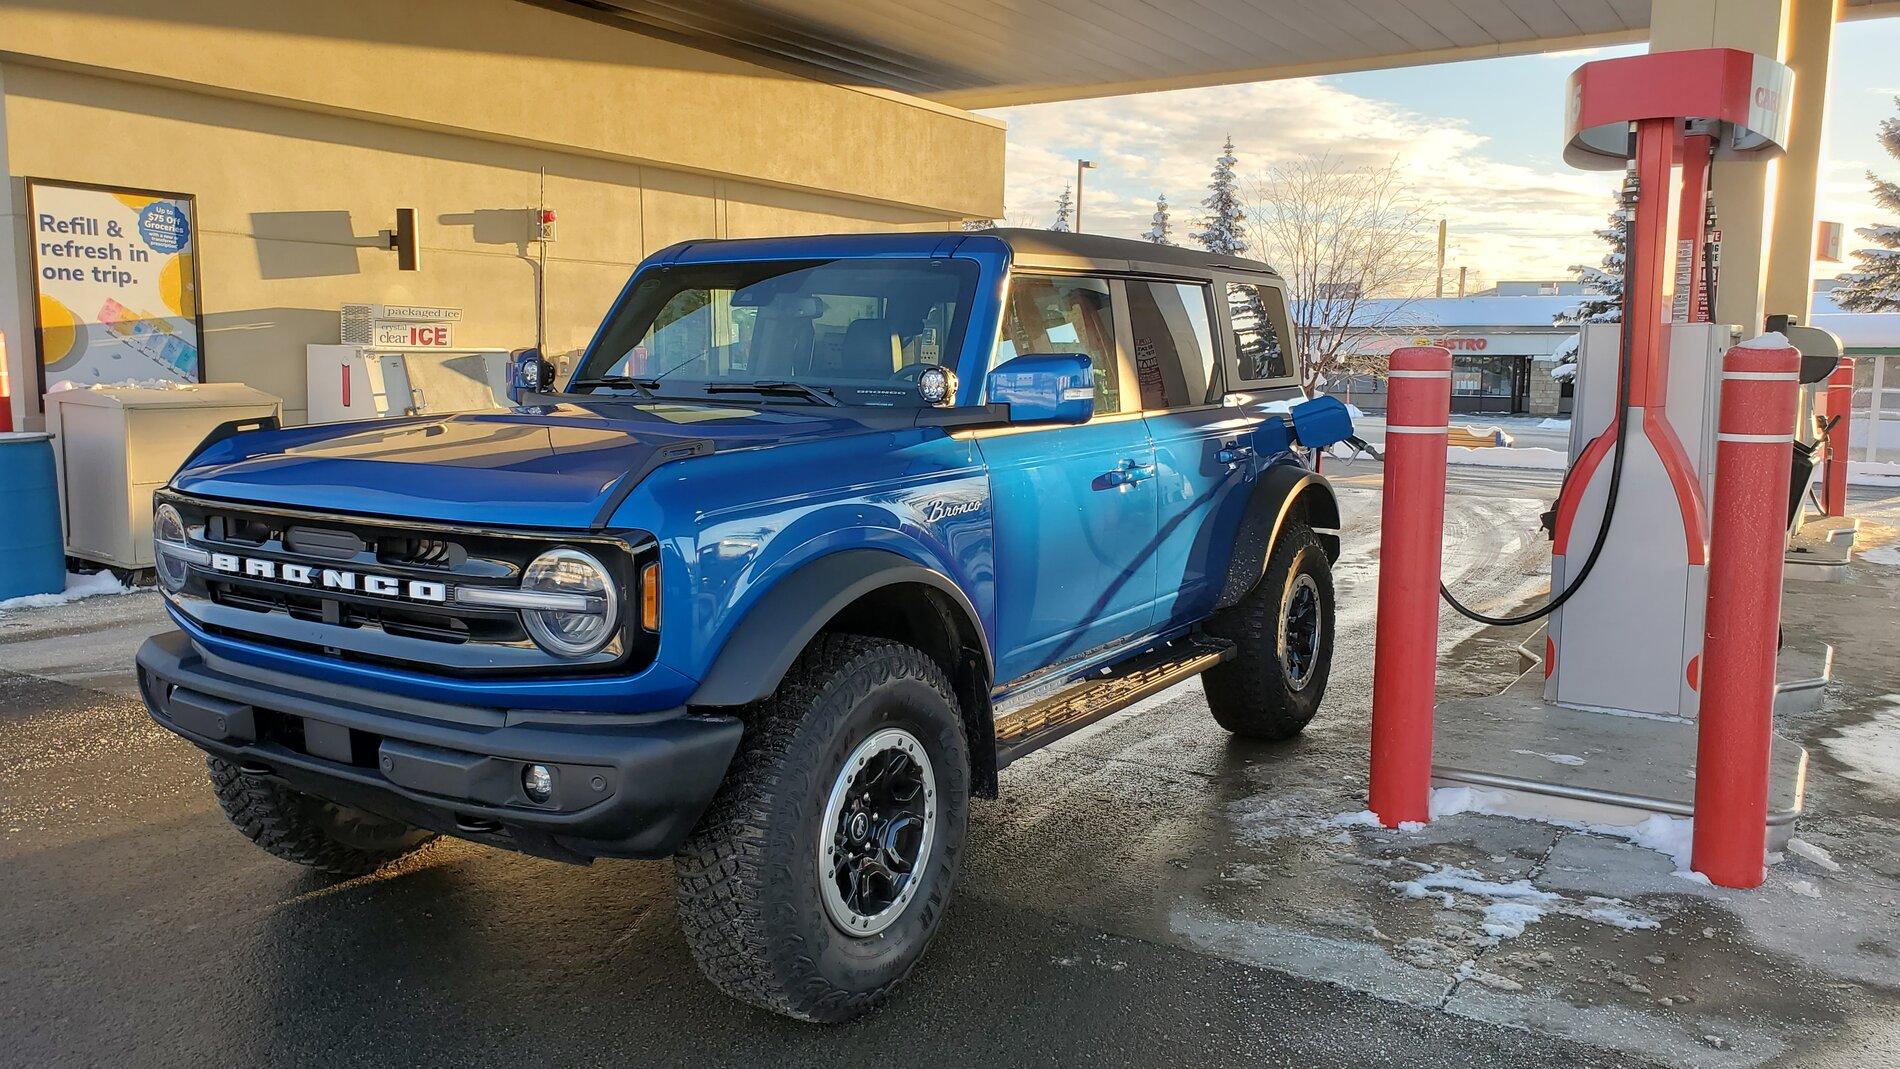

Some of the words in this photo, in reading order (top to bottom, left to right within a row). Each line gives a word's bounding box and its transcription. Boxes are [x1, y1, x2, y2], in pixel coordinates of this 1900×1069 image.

[148, 212, 165, 223] $75
[166, 216, 181, 226] Off
[156, 206, 166, 214] Up
[39, 213, 99, 236] Refill
[106, 219, 124, 238] &
[144, 220, 184, 234] Groceries
[41, 240, 122, 261] refresh
[129, 243, 149, 262] in
[42, 266, 85, 281] one
[91, 265, 138, 287] trip.
[387, 308, 441, 318] packaged
[444, 310, 460, 318] ice
[379, 331, 408, 344] clear
[410, 326, 448, 346] ICE
[926, 499, 983, 523] Bronco
[212, 553, 446, 602] BRONCO
